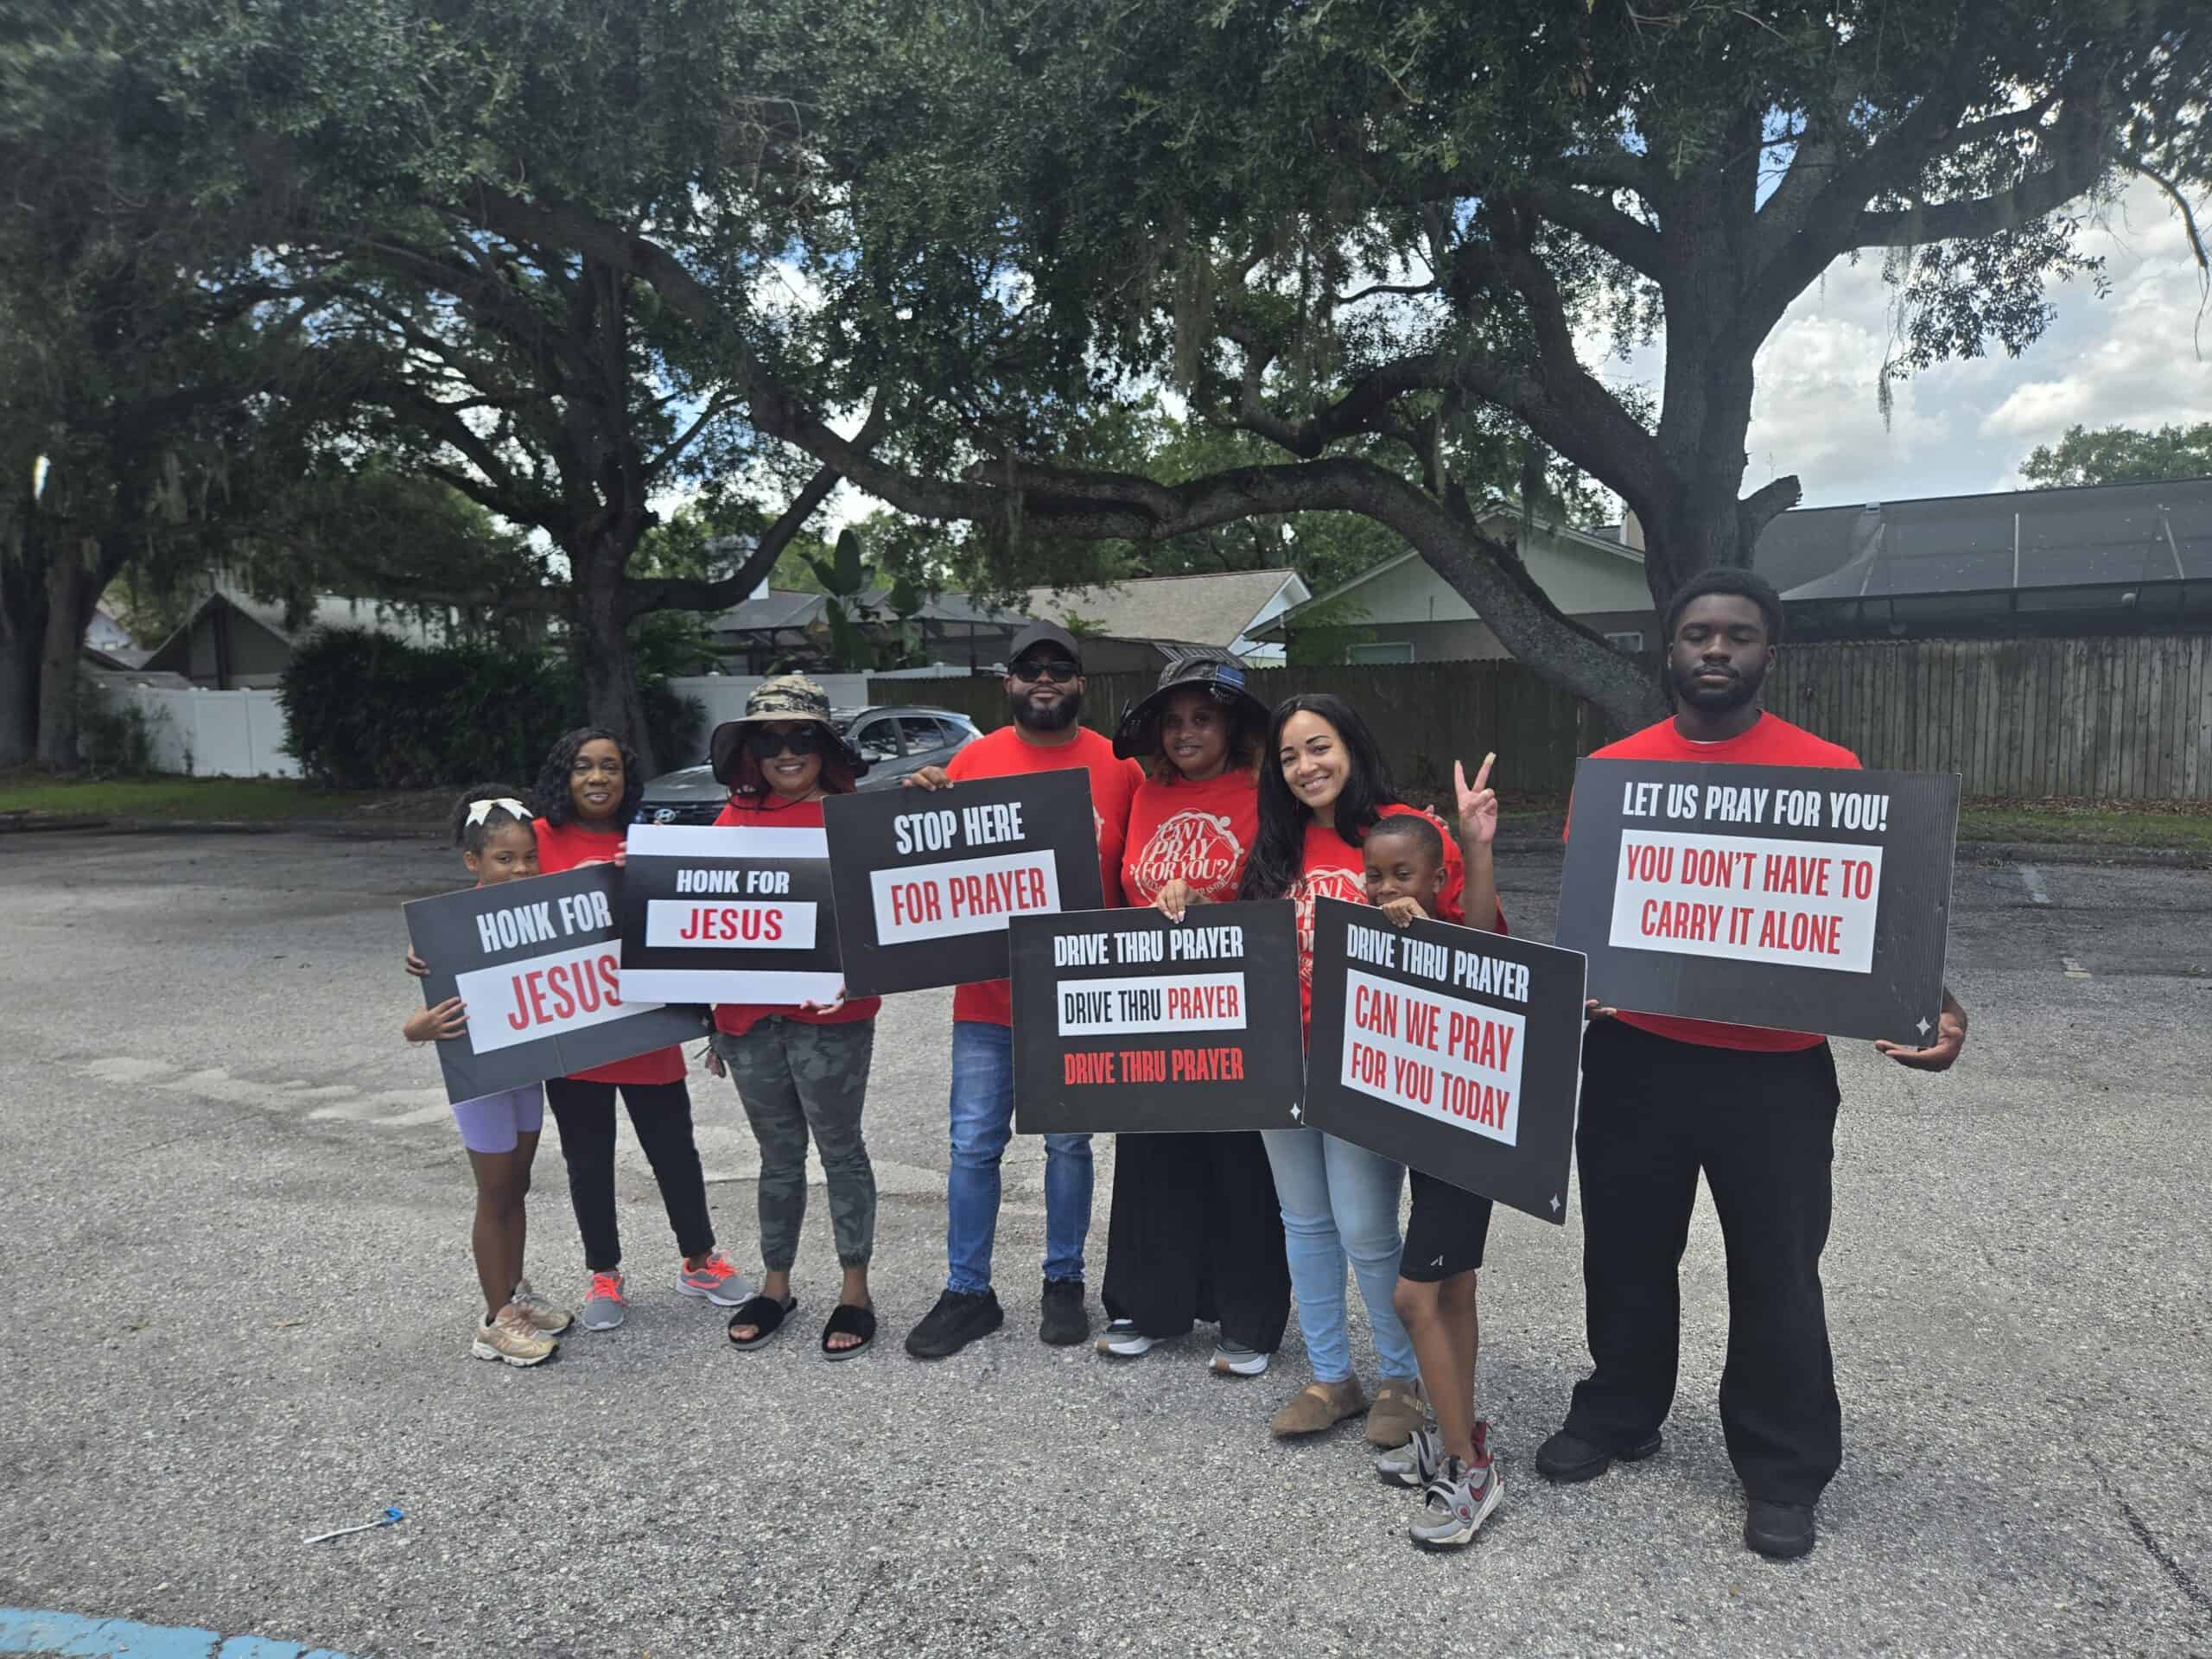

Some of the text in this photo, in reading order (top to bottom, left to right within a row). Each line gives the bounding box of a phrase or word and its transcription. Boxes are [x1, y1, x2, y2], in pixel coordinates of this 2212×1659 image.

[894, 802, 1025, 854] STOP HERE
[1160, 821, 1205, 841] CAN I
[1623, 782, 1890, 831] LET US PRAY FOR YOU!
[1142, 858, 1228, 880] FOR YOU?
[1148, 837, 1218, 862] PRAY
[1627, 844, 1873, 899] YOU DON'T HAVE TO
[677, 870, 790, 893] HONK FOR
[890, 868, 1047, 926] FOR PRAYER
[476, 891, 613, 953] HONK FOR
[681, 908, 782, 941] JESUS
[1054, 925, 1244, 967] DRIVE THRU PRAYER
[1641, 899, 1843, 955] CARRY IT ALONE
[1347, 925, 1396, 969] DRIVE
[1402, 938, 1448, 981] THRU
[1453, 950, 1529, 1003] PRAYER
[507, 954, 622, 1030] JESUS
[1065, 985, 1239, 1024] DRIVE THRU PRAYER
[1354, 984, 1514, 1071] CAN WE PRAY
[1065, 1047, 1244, 1084] DRIVE THRU PRAYER
[1351, 1041, 1510, 1130] FOR YOU TODAY
